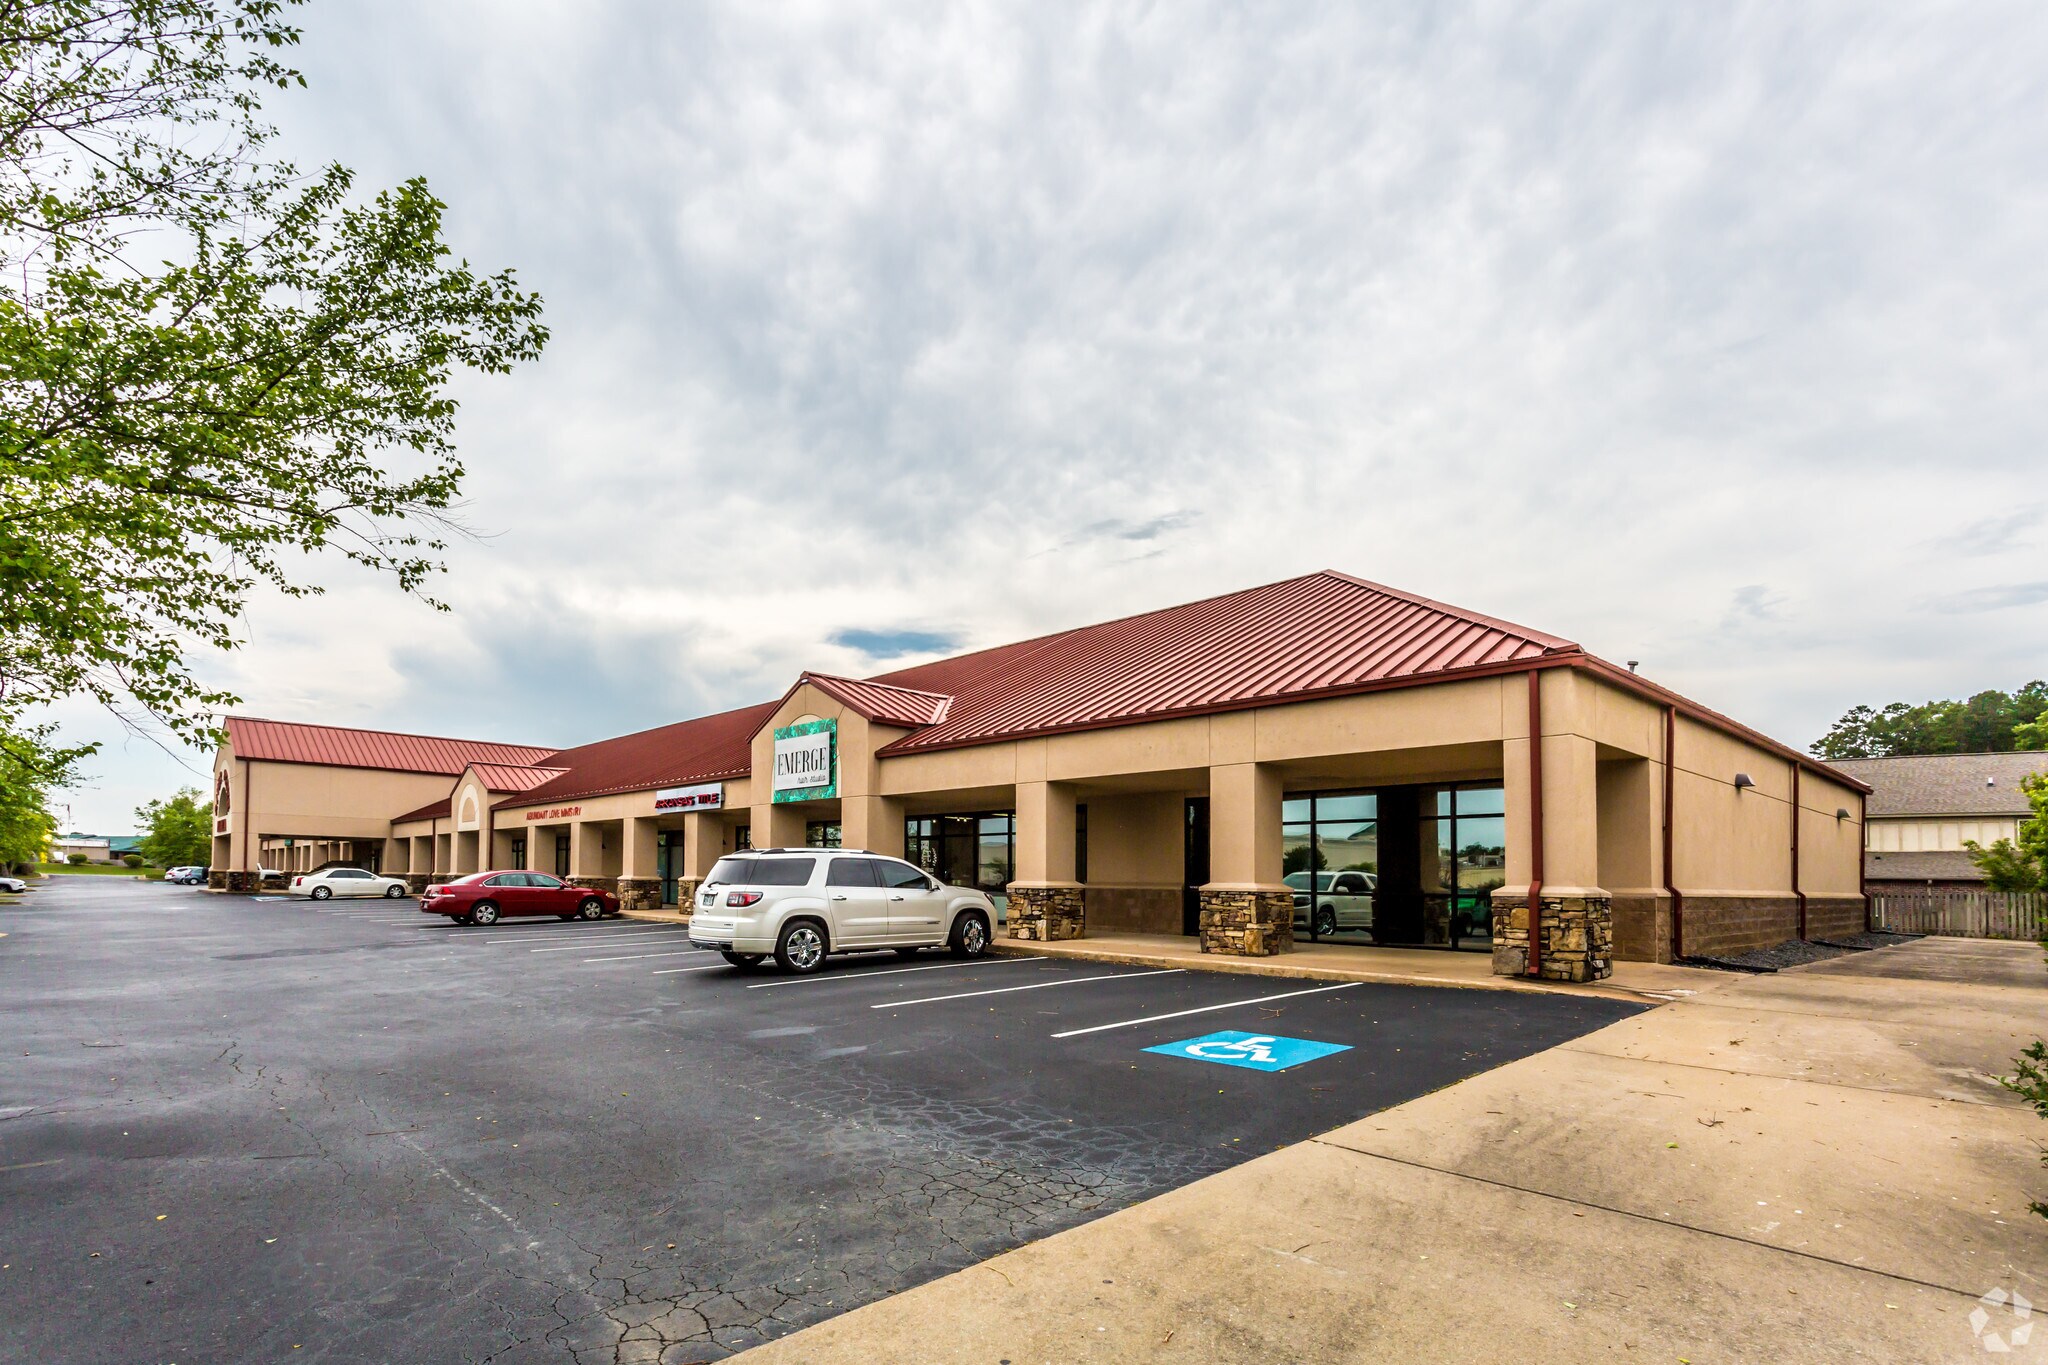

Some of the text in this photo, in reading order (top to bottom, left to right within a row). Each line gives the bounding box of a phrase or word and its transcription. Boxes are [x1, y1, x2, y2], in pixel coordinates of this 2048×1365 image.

[777, 747, 827, 776] EMERGE
[655, 793, 719, 808] ARKANSAS TITLE
[526, 806, 582, 820] ABUNDANT LOVE MINISTRY
